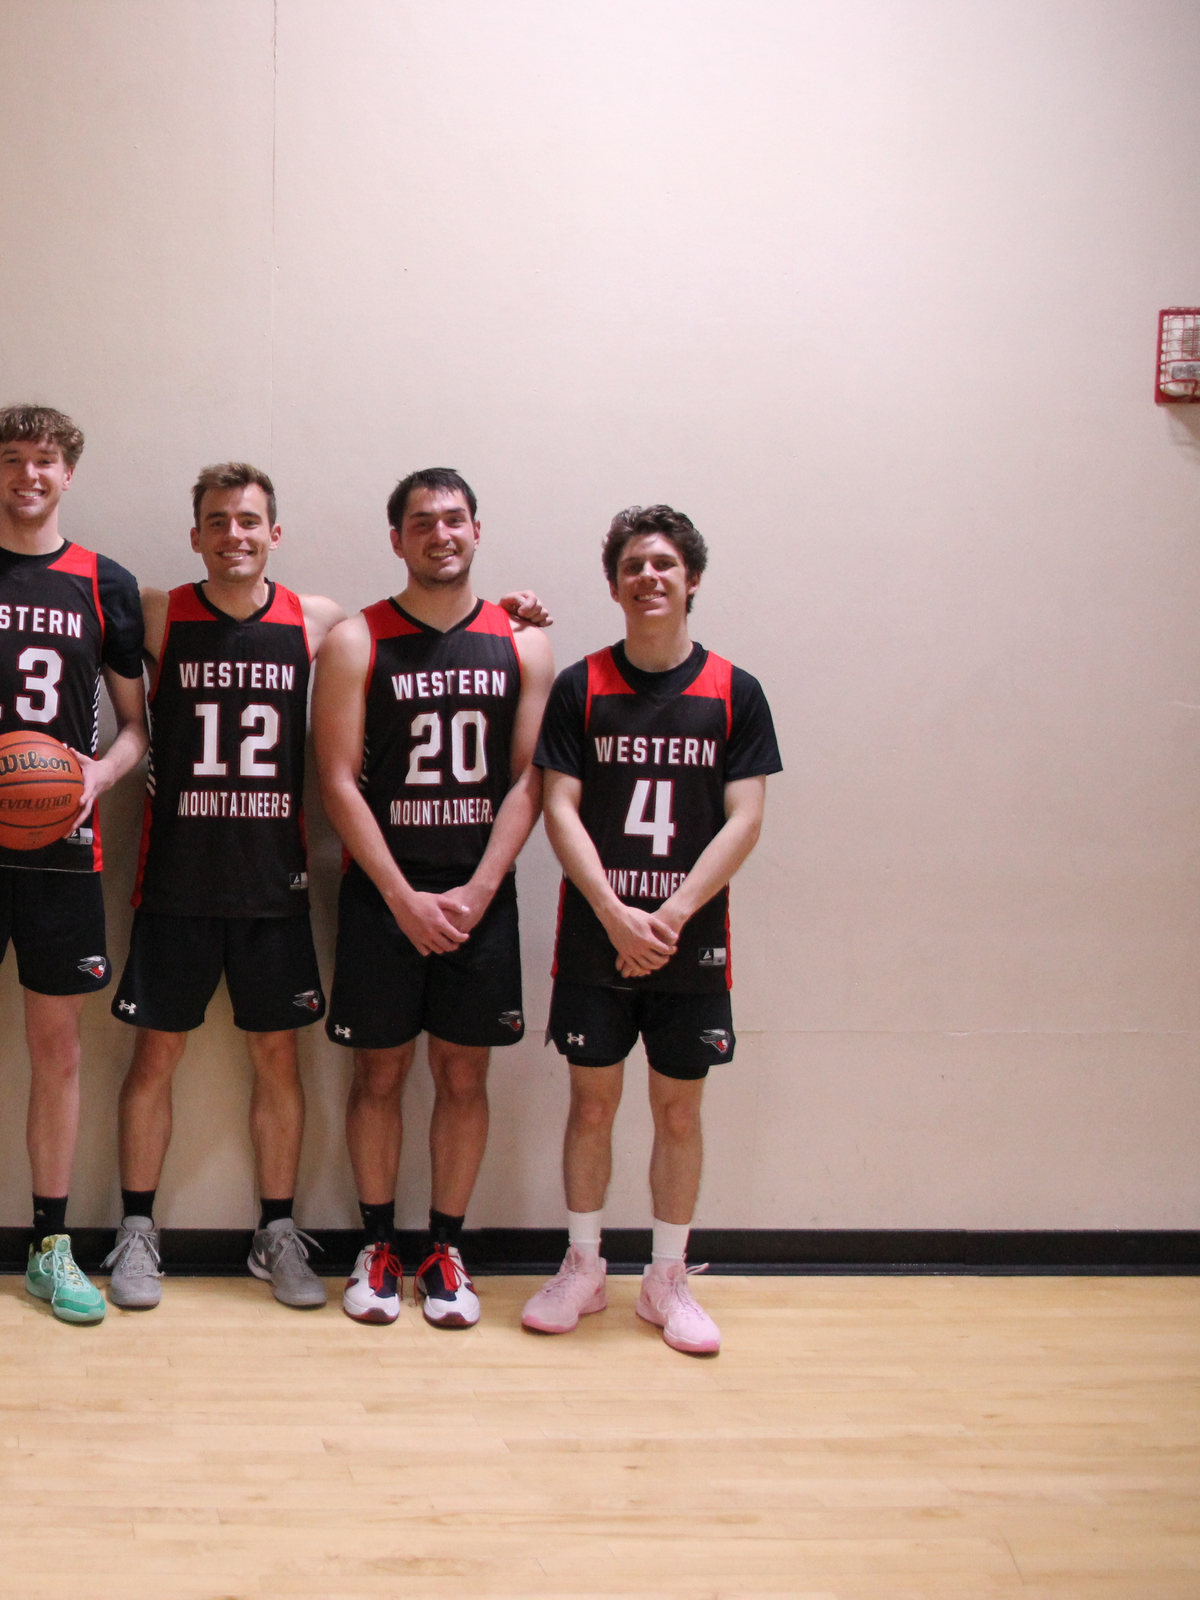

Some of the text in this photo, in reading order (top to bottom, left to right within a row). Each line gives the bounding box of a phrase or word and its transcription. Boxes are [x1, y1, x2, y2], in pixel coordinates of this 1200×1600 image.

[179, 662, 294, 690] WESTERN
[391, 669, 506, 700] WESTERN
[193, 703, 279, 776] 12
[405, 710, 487, 784] 20
[594, 737, 716, 767] WESTERN
[0, 794, 72, 810] EVOLUTION
[178, 791, 291, 817] MOUNTAINEERS
[623, 779, 675, 856] 4
[607, 869, 686, 898] UNTAINE
